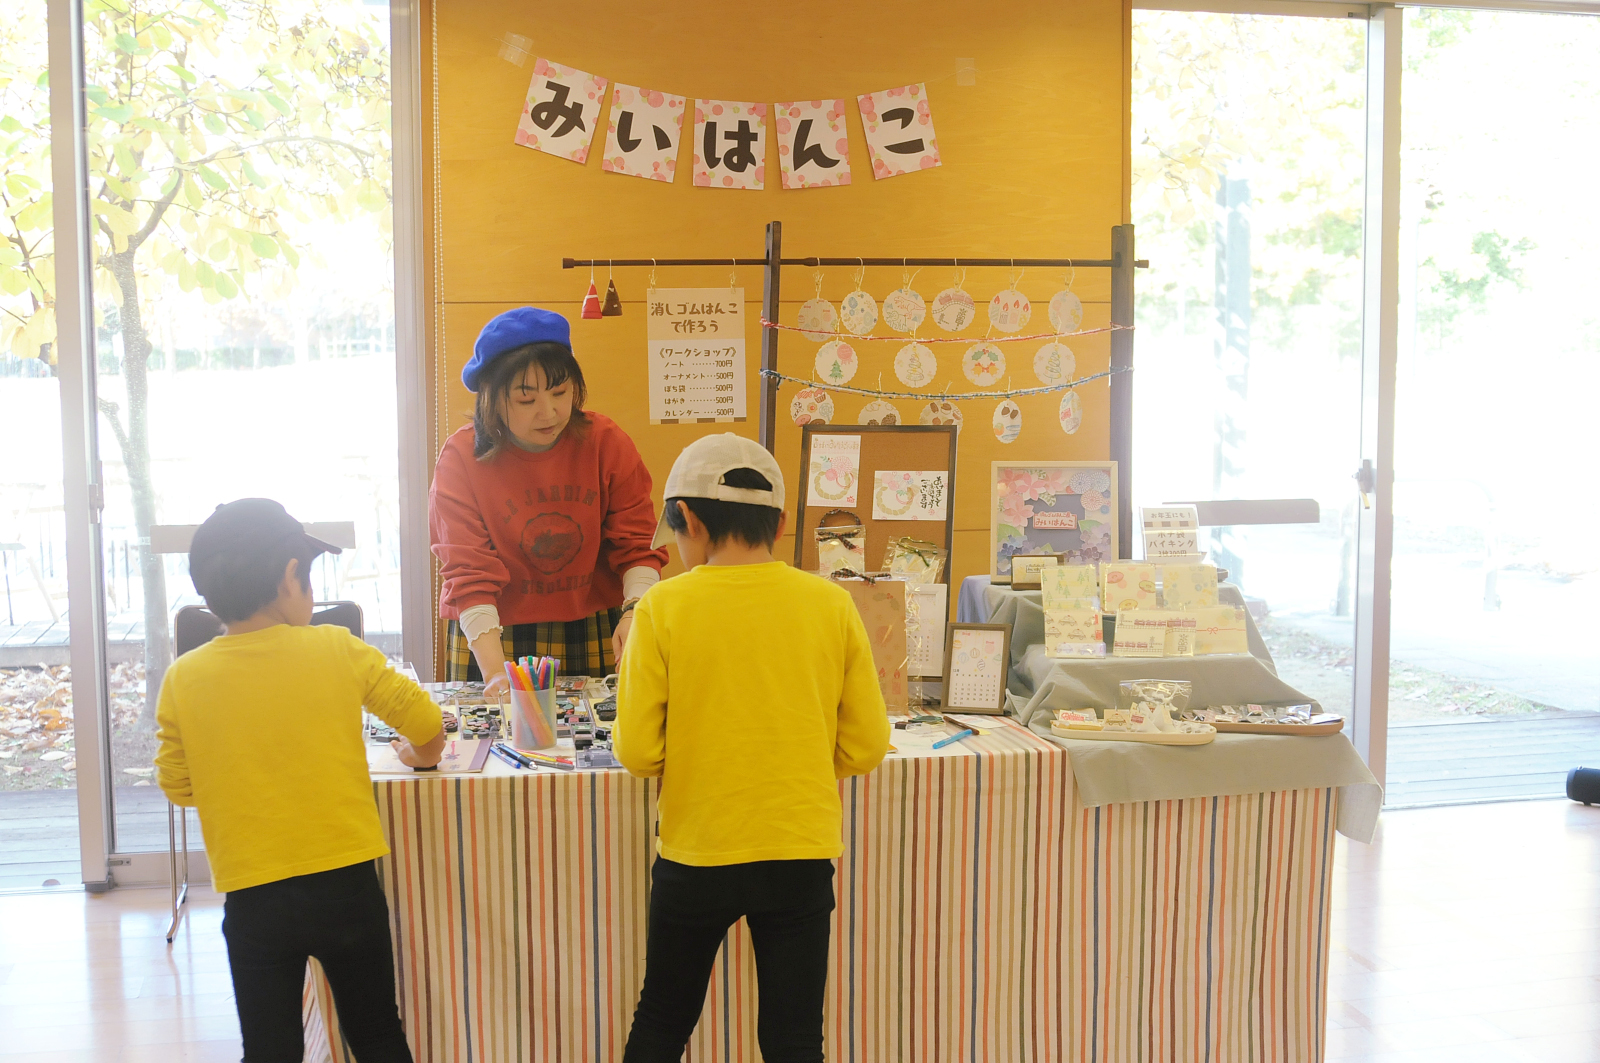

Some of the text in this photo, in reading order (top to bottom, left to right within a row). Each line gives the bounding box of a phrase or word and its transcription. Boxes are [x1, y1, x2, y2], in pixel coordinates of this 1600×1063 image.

[530, 80, 925, 173] みいはんこ
[650, 301, 738, 317] 消しゴムはんこ
[671, 319, 719, 333] で作ろう
[524, 485, 598, 506] JARDIN
[1149, 539, 1195, 548] バイキング
